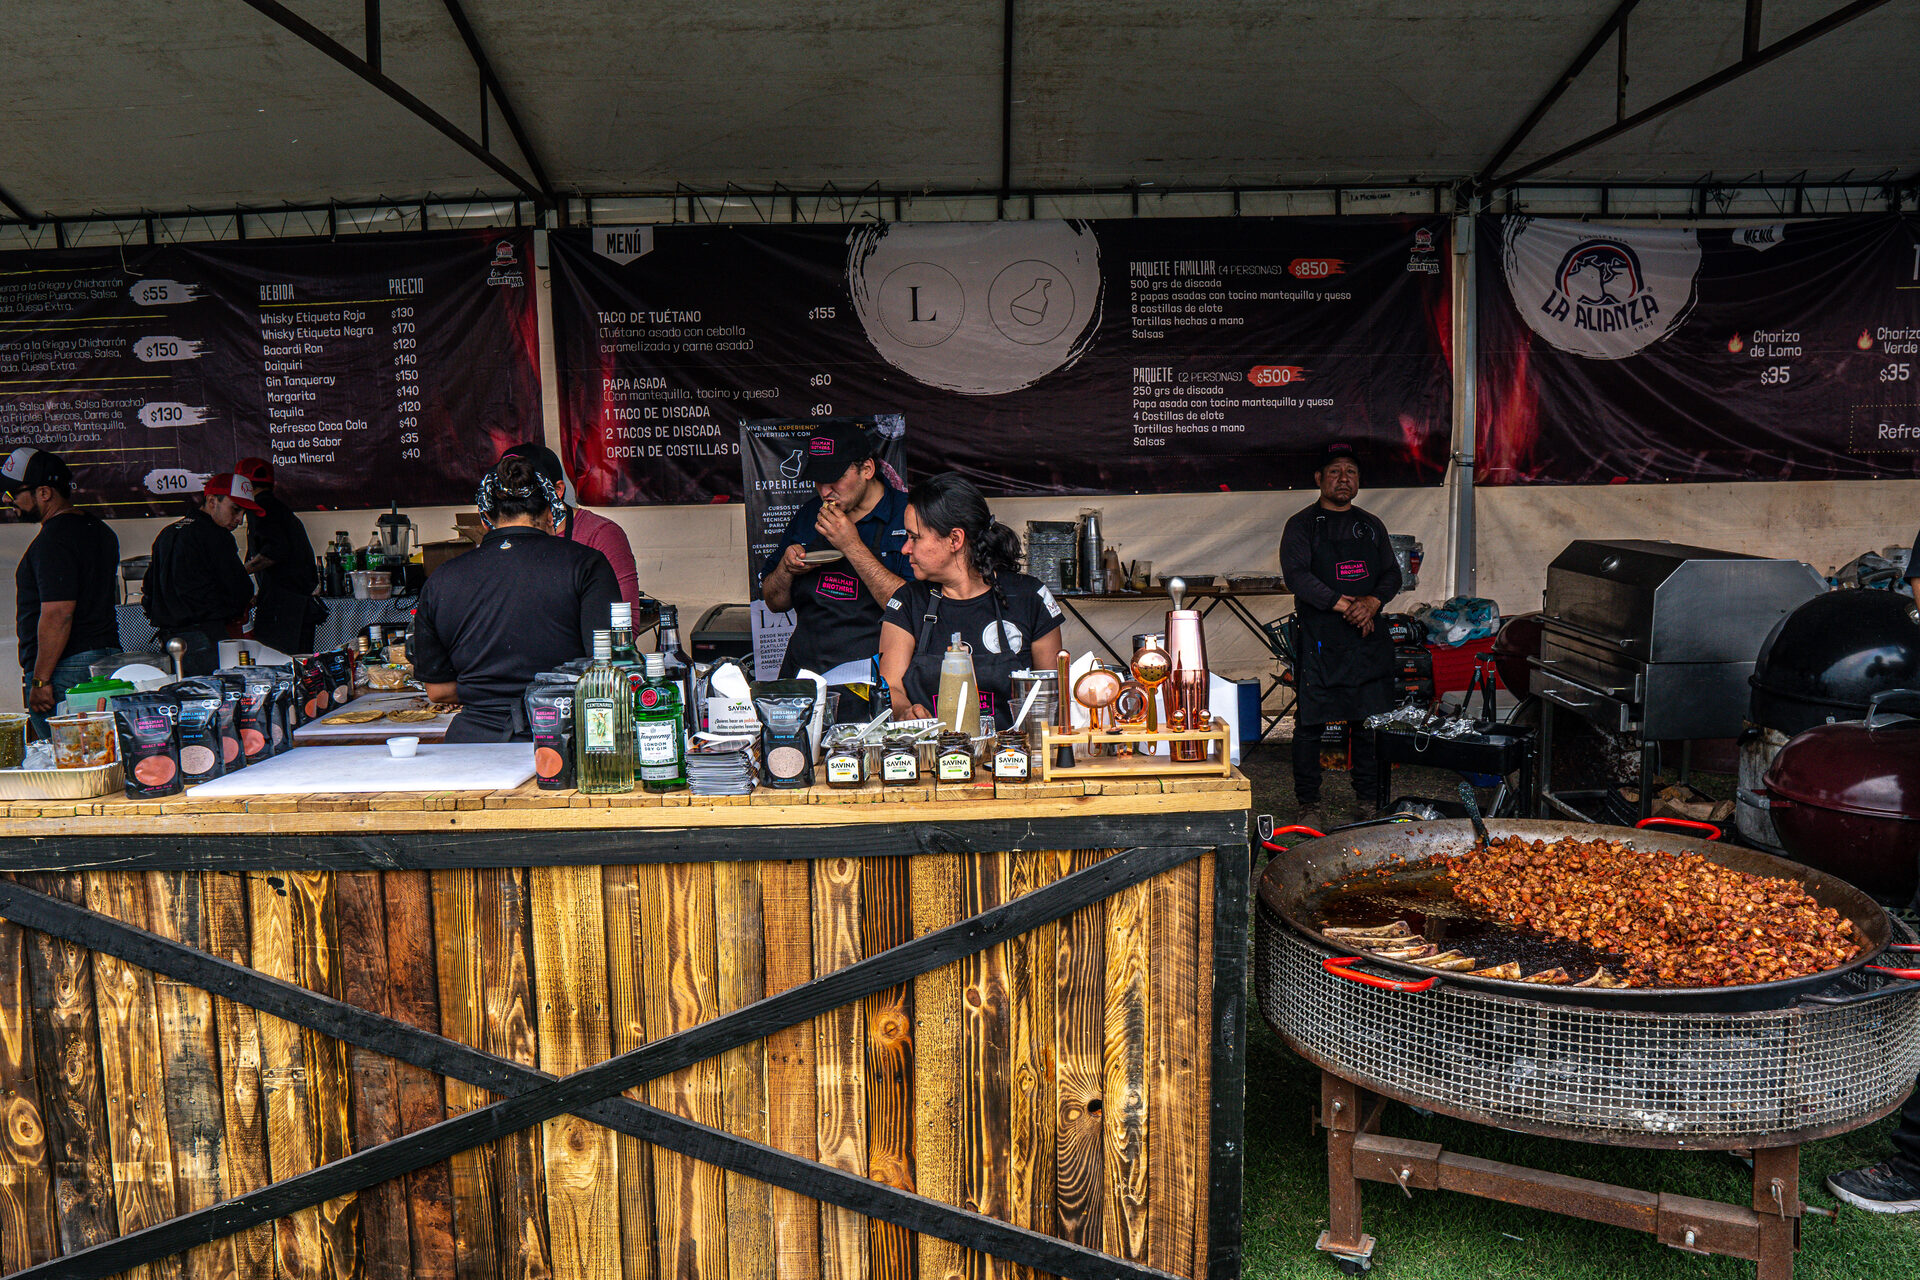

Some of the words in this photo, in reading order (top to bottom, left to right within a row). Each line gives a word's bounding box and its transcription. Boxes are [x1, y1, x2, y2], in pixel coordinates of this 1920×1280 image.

[606, 229, 640, 254] MENÚ
[1744, 226, 1775, 244] MENÚ
[1130, 261, 1170, 278] PAQUETE
[1174, 260, 1216, 276] FAMILIAR
[1218, 267, 1228, 276] (4
[1231, 265, 1282, 275] PERSONAS)
[1296, 262, 1329, 277] $850
[260, 284, 295, 300] BEBIDA
[388, 278, 424, 295] PRECIO
[1131, 279, 1149, 289] 500
[1152, 281, 1168, 290] grs
[1171, 279, 1182, 289] de
[1184, 278, 1222, 288] discada
[143, 286, 168, 302] $55
[1131, 292, 1137, 301] 2
[1140, 293, 1169, 303] papas
[1171, 291, 1206, 300] asadas
[1209, 292, 1226, 300] con
[1228, 291, 1258, 300] tocino
[1260, 290, 1314, 302] mantequilla
[1324, 292, 1351, 301] queso
[907, 287, 937, 322] L
[1132, 304, 1137, 313] 8
[1140, 304, 1182, 313] costillas
[1185, 303, 1196, 313] de
[1199, 304, 1222, 313] elote
[1541, 290, 1570, 322] LA
[1574, 294, 1660, 332] ALIANZA
[260, 312, 294, 325] Whisky
[296, 311, 340, 324] Etiqueta
[344, 310, 366, 322] Roja
[391, 307, 414, 319] $130
[598, 312, 626, 324] TACO
[630, 312, 645, 323] DE
[649, 308, 702, 323] TUÉTANO
[809, 307, 836, 320] $155
[1132, 316, 1172, 326] Tortillas
[1174, 316, 1208, 326] hechas
[1219, 317, 1244, 325] mano
[262, 328, 294, 341] Whisky
[297, 327, 341, 339] Etiqueta
[344, 325, 374, 338] Negra
[392, 322, 415, 334] $170
[599, 326, 646, 339] (Tuétano
[648, 327, 681, 338] asado
[684, 328, 703, 337] con
[706, 326, 746, 336] cebolla
[1132, 329, 1164, 339] Salsas
[1753, 330, 1800, 343] Chorizo
[146, 342, 178, 359] $150
[263, 344, 301, 356] Bacardi
[304, 343, 323, 354] Ron
[393, 338, 417, 350] $120
[682, 342, 713, 351] carne
[1884, 341, 1918, 354] Verde
[1750, 345, 1765, 357] de
[1768, 345, 1802, 357] Lomo
[264, 360, 303, 372] Daiquiri
[394, 354, 417, 366] $140
[396, 370, 418, 382] $150
[1133, 367, 1173, 384] PAQUETE
[1178, 373, 1188, 383] (2
[1191, 372, 1243, 383] PERSONAS)
[1258, 369, 1291, 384] $500
[1760, 366, 1790, 385] $35
[1880, 363, 1910, 383] $35
[266, 376, 281, 387] Gin
[284, 375, 336, 387] Tanqueray
[603, 379, 631, 391] PAPA
[633, 377, 667, 389] ASADA
[810, 374, 832, 386] $60
[267, 391, 316, 404] Margarita
[396, 385, 420, 397] $140
[603, 390, 627, 402] (Con
[696, 388, 731, 399] tocino
[742, 387, 780, 400] queso)
[1133, 387, 1152, 396] 250
[1154, 388, 1171, 398] grs
[1173, 386, 1184, 396] de
[1186, 386, 1224, 395] discada
[398, 401, 421, 413] $120
[1134, 399, 1157, 409] Papa
[1159, 398, 1188, 408] asada
[1190, 399, 1207, 407] con
[1210, 398, 1240, 407] tocino
[1242, 397, 1297, 409] mantequilla
[1306, 399, 1334, 408] queso
[151, 407, 182, 422] $130
[269, 407, 305, 420] Tequila
[605, 408, 610, 420] 1
[613, 408, 641, 420] TACO
[644, 407, 658, 419] DE
[662, 405, 710, 418] DISCADA
[811, 404, 832, 416] $60
[1134, 412, 1139, 421] 4
[1142, 411, 1184, 421] Costillas
[1186, 411, 1198, 420] de
[1200, 411, 1224, 420] elote
[269, 422, 316, 434] Refresco
[318, 421, 343, 432] Coca
[345, 419, 368, 430] Cola
[399, 417, 417, 428] $40
[1134, 424, 1173, 434] Tortillas
[1175, 424, 1209, 433] hechas
[400, 432, 419, 444] $35
[606, 428, 613, 440] 2
[617, 427, 651, 439] TACOS
[655, 426, 670, 438] DE
[673, 425, 721, 437] DISCADA
[271, 439, 295, 451] Agua
[298, 437, 310, 448] de
[312, 436, 342, 447] Sabor
[1134, 437, 1166, 446] Salsas
[402, 448, 420, 460] $40
[606, 446, 645, 458] ORDEN
[649, 445, 663, 456] DE
[666, 444, 729, 456] COSTILLAS
[272, 454, 297, 467] Agua
[300, 452, 335, 463] Mineral
[156, 475, 187, 491] $140
[760, 610, 794, 628] LA
